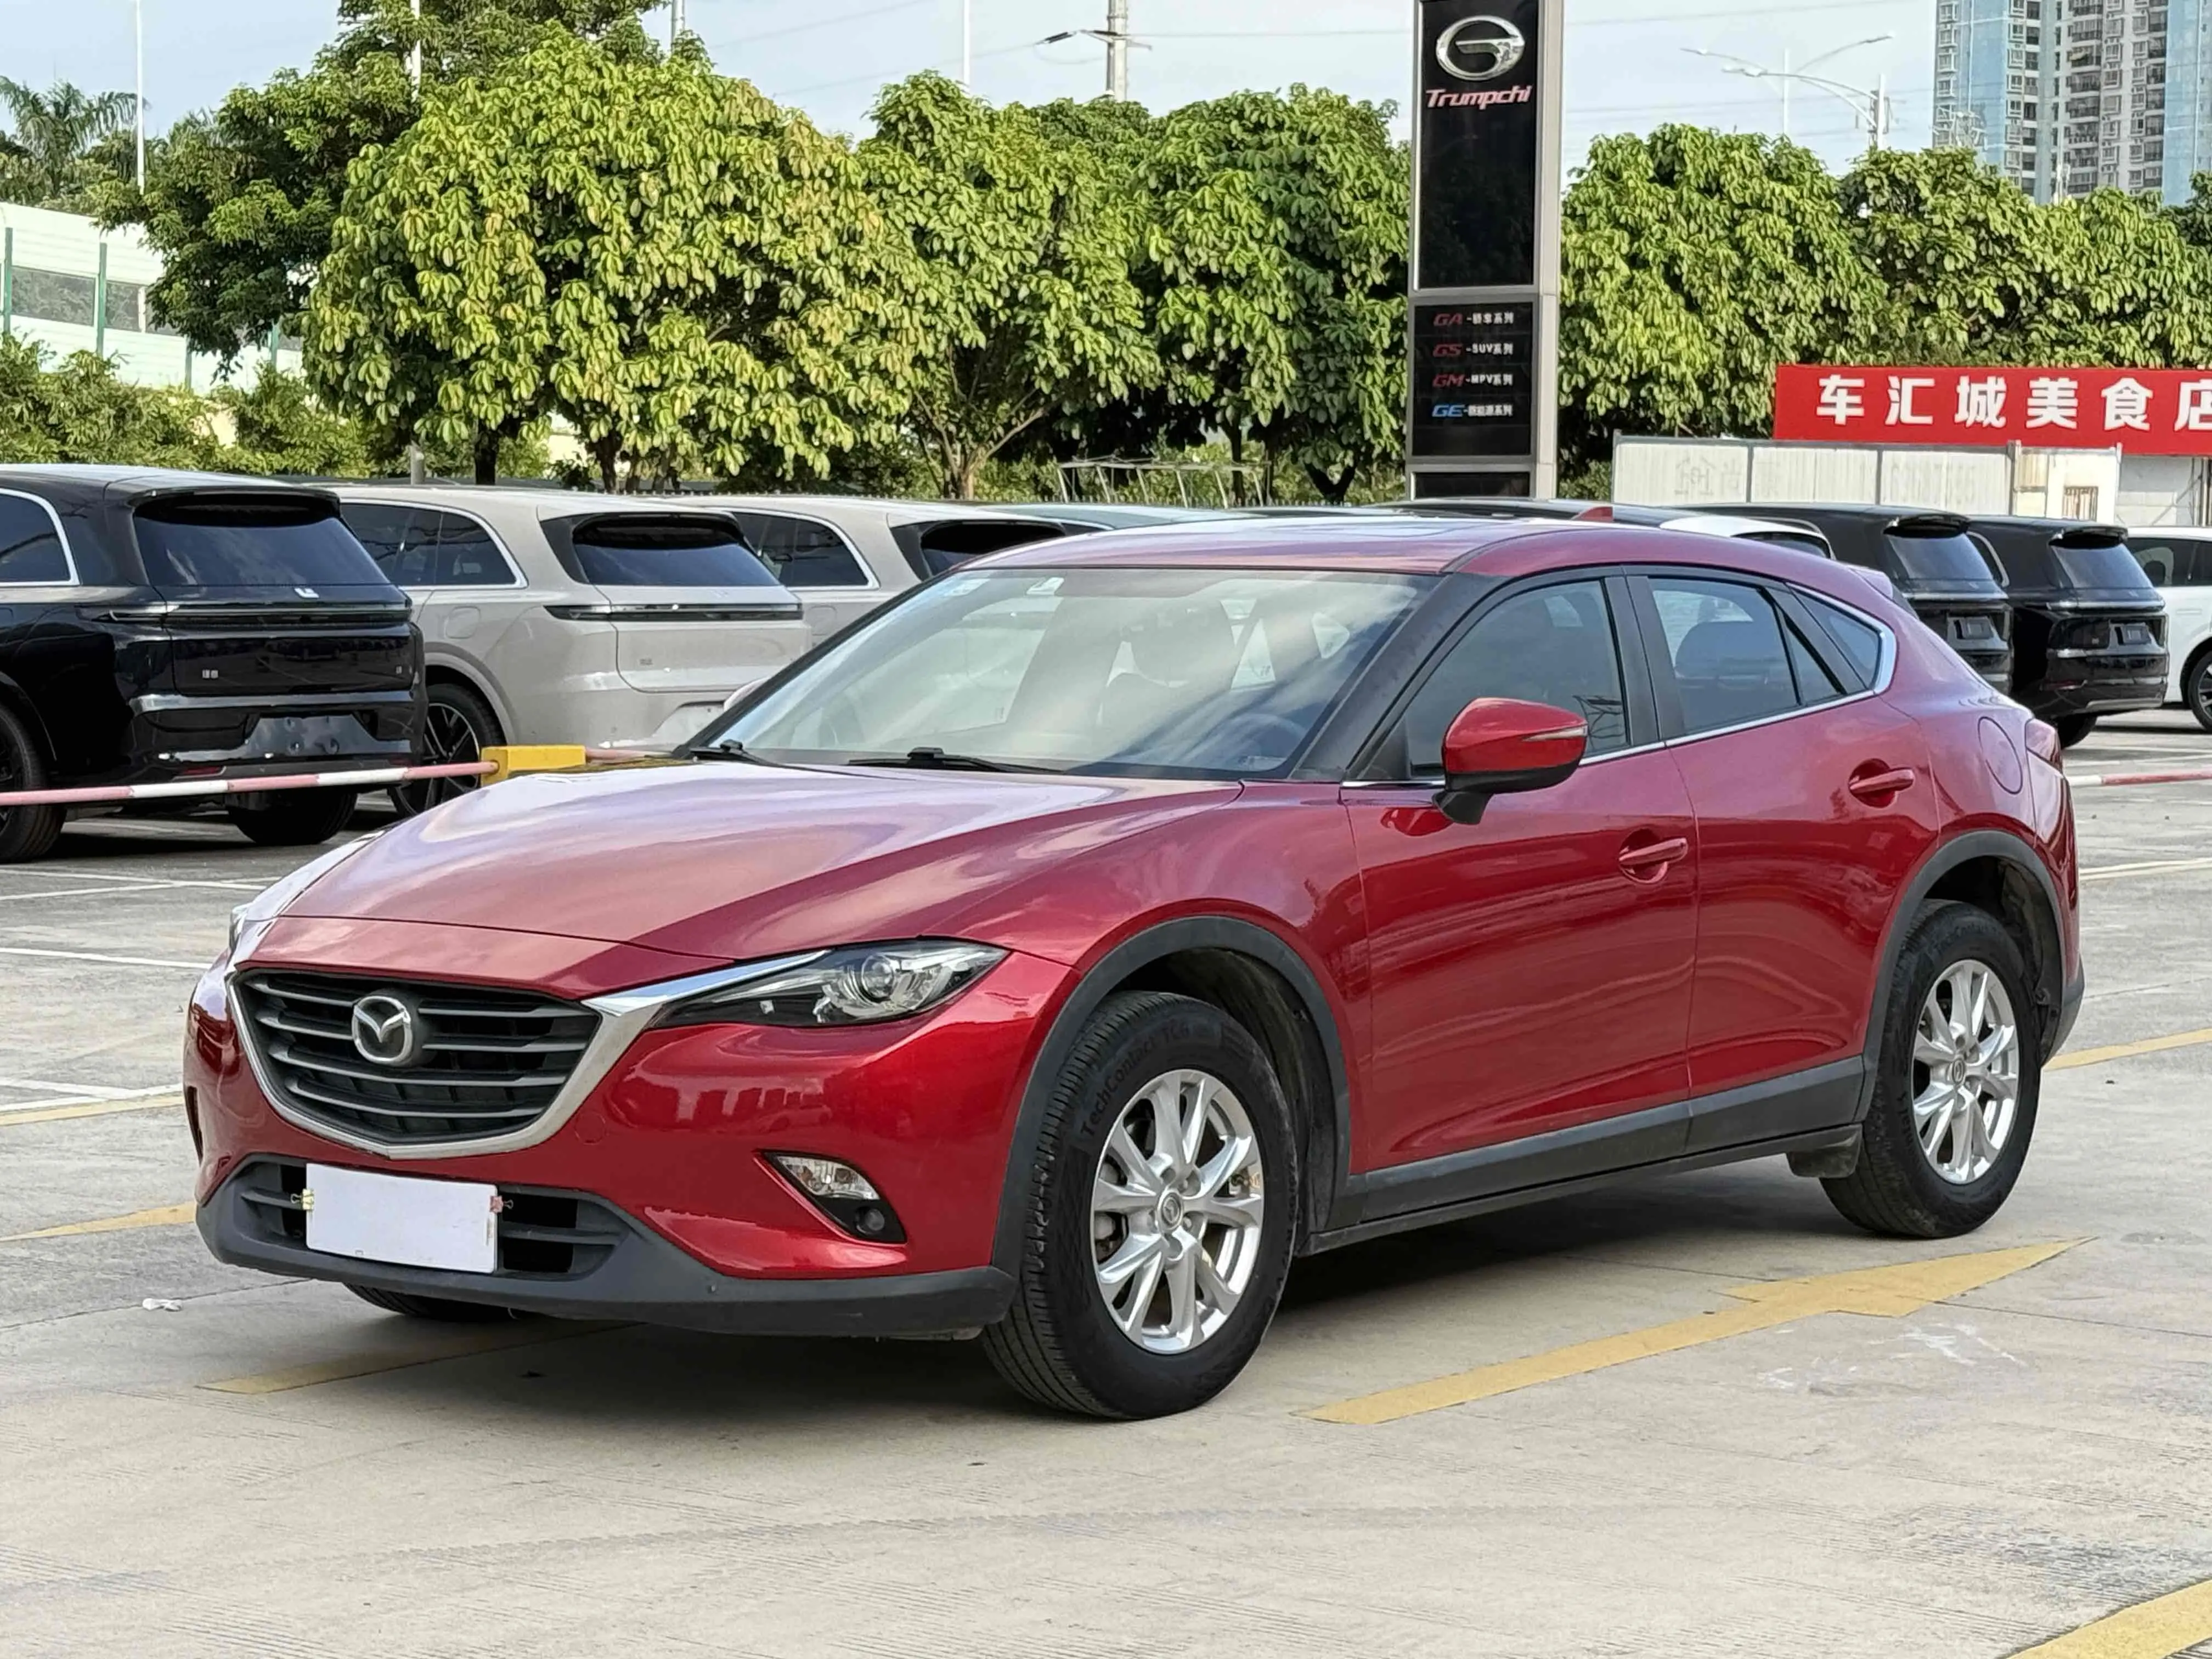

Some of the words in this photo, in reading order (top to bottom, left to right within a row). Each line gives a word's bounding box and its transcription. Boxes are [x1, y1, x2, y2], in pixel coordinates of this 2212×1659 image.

[1426, 85, 1533, 110] Trumpchi
[1816, 374, 2212, 432] 车汇城美食店
